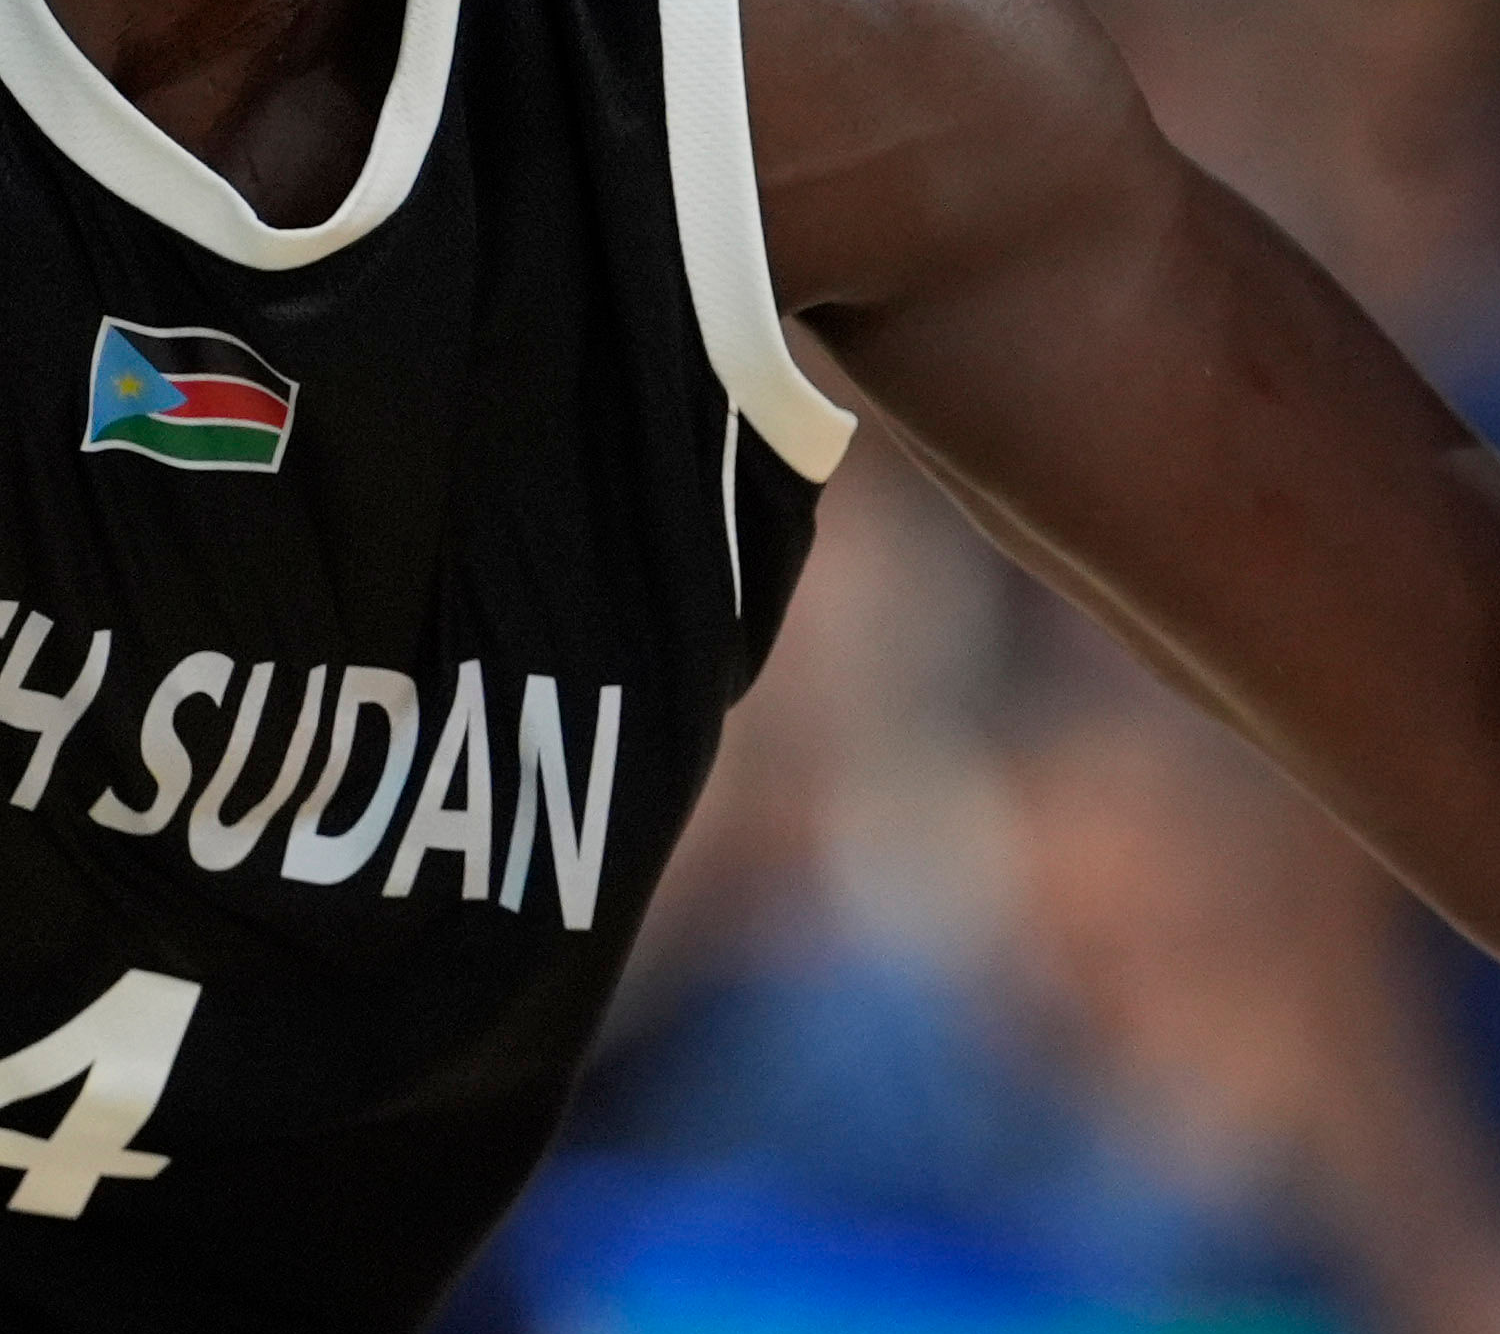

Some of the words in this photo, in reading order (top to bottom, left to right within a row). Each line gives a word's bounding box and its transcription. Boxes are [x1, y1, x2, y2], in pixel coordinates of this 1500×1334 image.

[0, 599, 112, 812] H
[88, 651, 622, 931] SUDAN
[0, 967, 203, 1221] 4
